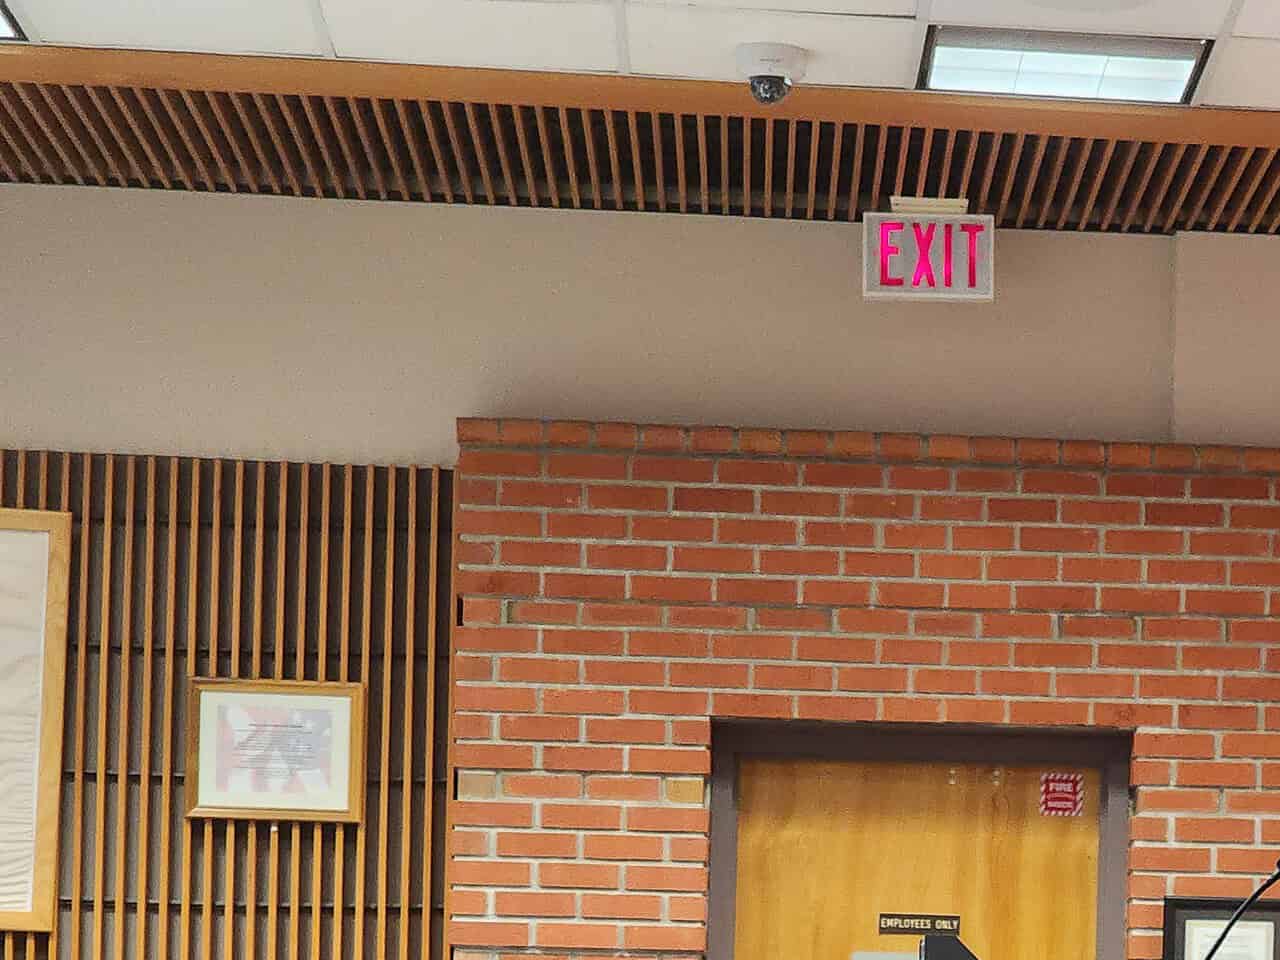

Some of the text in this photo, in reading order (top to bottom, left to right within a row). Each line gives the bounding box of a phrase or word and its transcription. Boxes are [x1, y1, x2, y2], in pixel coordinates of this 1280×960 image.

[879, 221, 985, 288] EXIT
[880, 917, 959, 930] EMPLOYEES ONLY
